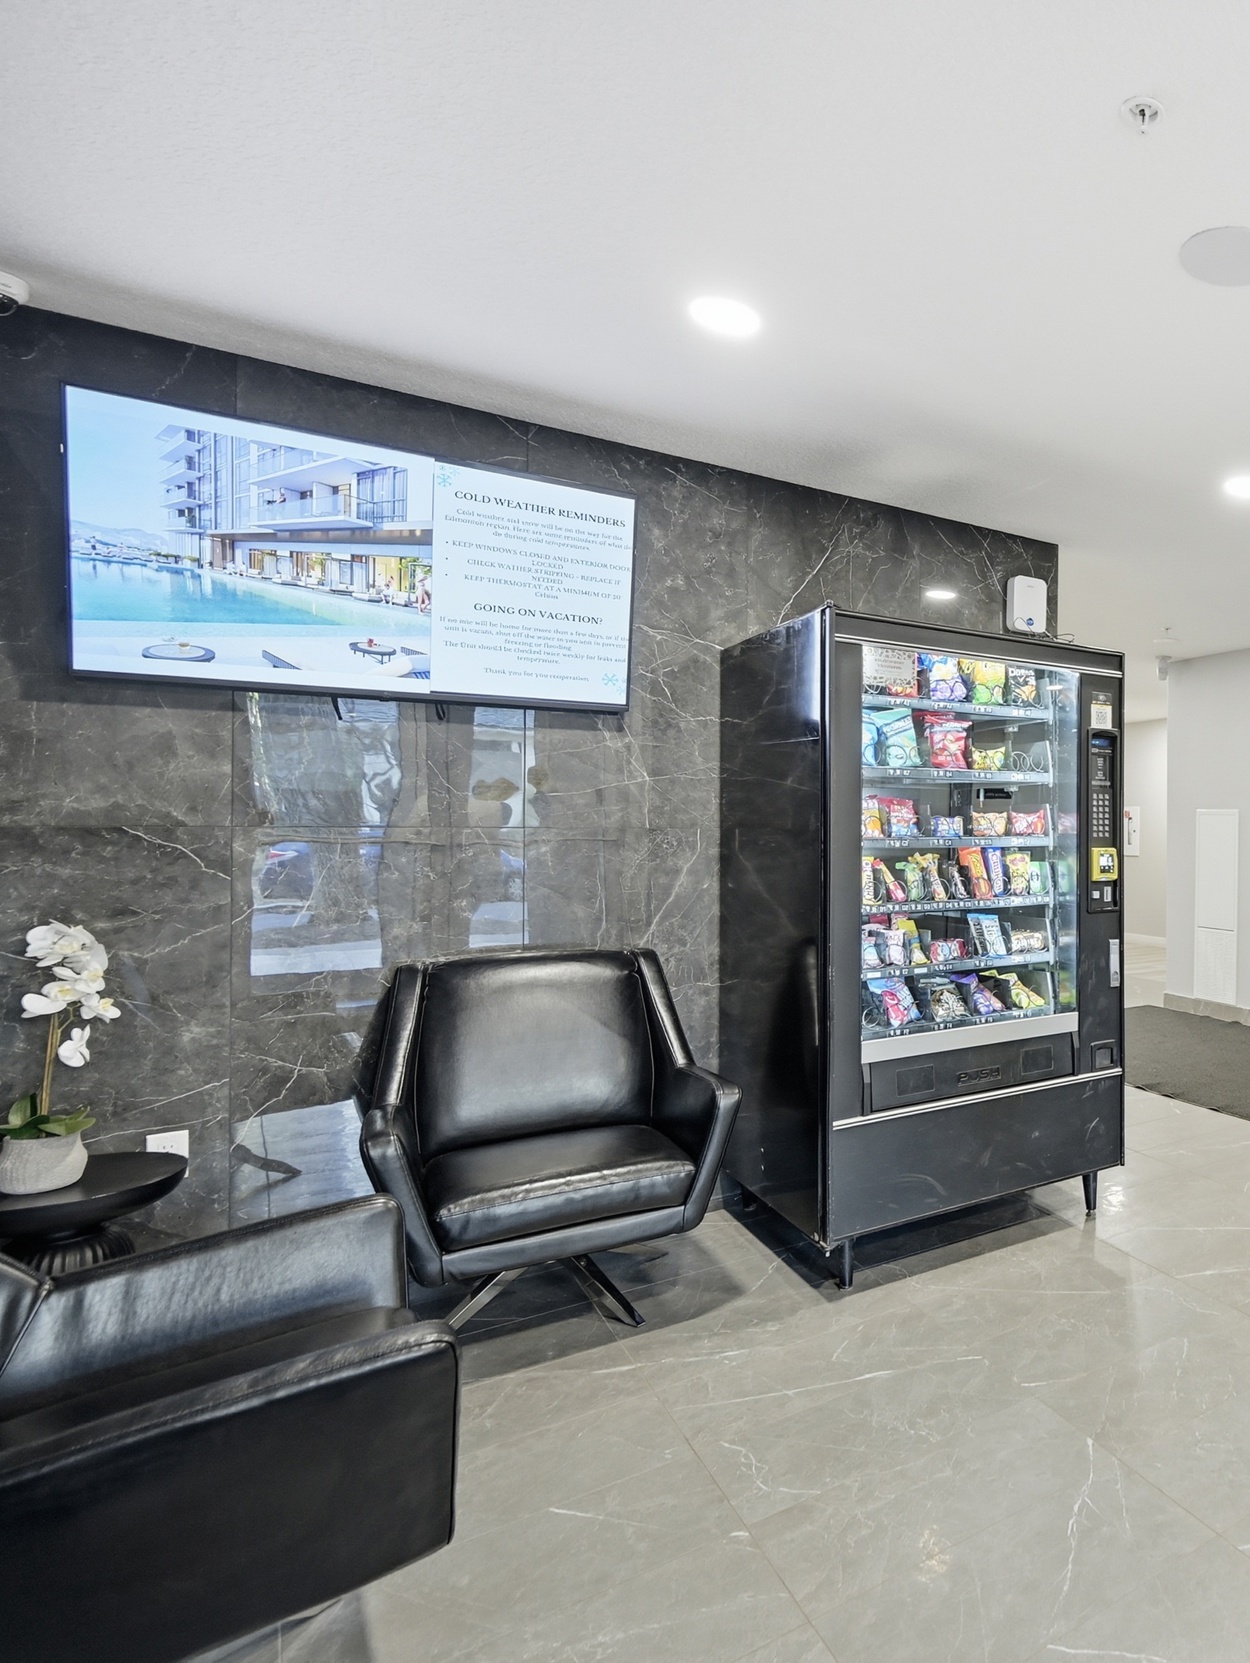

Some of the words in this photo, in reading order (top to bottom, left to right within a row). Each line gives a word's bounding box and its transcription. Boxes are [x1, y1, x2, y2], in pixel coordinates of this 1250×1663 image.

[454, 490, 490, 504] COLD
[493, 497, 554, 516] WEATHER
[558, 508, 626, 528] REMINDERS
[456, 508, 474, 516] Cold
[452, 540, 473, 548] KEEP
[475, 543, 517, 555] WINDOWS
[519, 550, 550, 560] CLOSED
[570, 558, 608, 569] EXTERIOR
[467, 558, 495, 567] CHECK
[531, 559, 563, 570] LOCKED
[464, 573, 484, 582] KEEP
[486, 576, 541, 589] THERMOSTAT
[531, 575, 562, 584] NEEDED
[473, 602, 514, 615] GOING
[518, 607, 536, 617] ON
[538, 610, 603, 625] VACATION?
